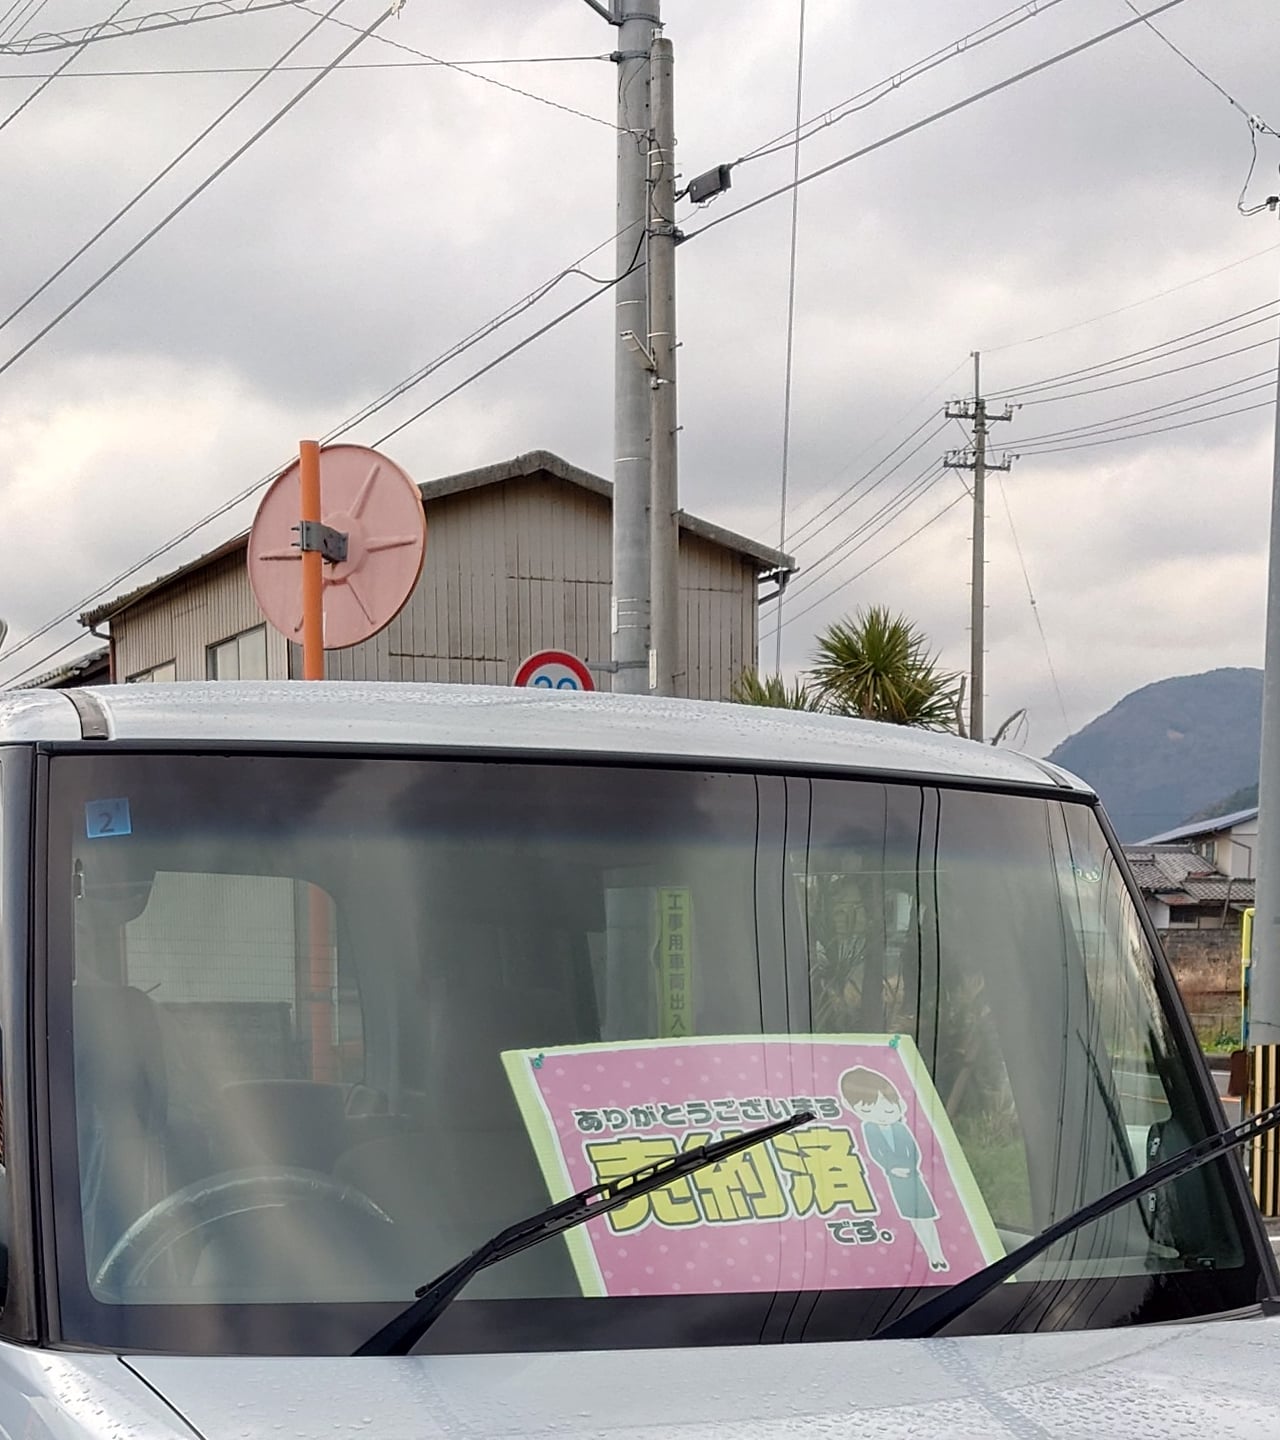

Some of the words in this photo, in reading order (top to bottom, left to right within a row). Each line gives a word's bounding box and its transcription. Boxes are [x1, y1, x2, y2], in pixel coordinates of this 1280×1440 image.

[667, 893, 686, 1038] 工事用車両出入
[573, 1098, 841, 1132] ありがとうございます
[587, 1128, 877, 1232] 売約済
[827, 1217, 893, 1245] です。
